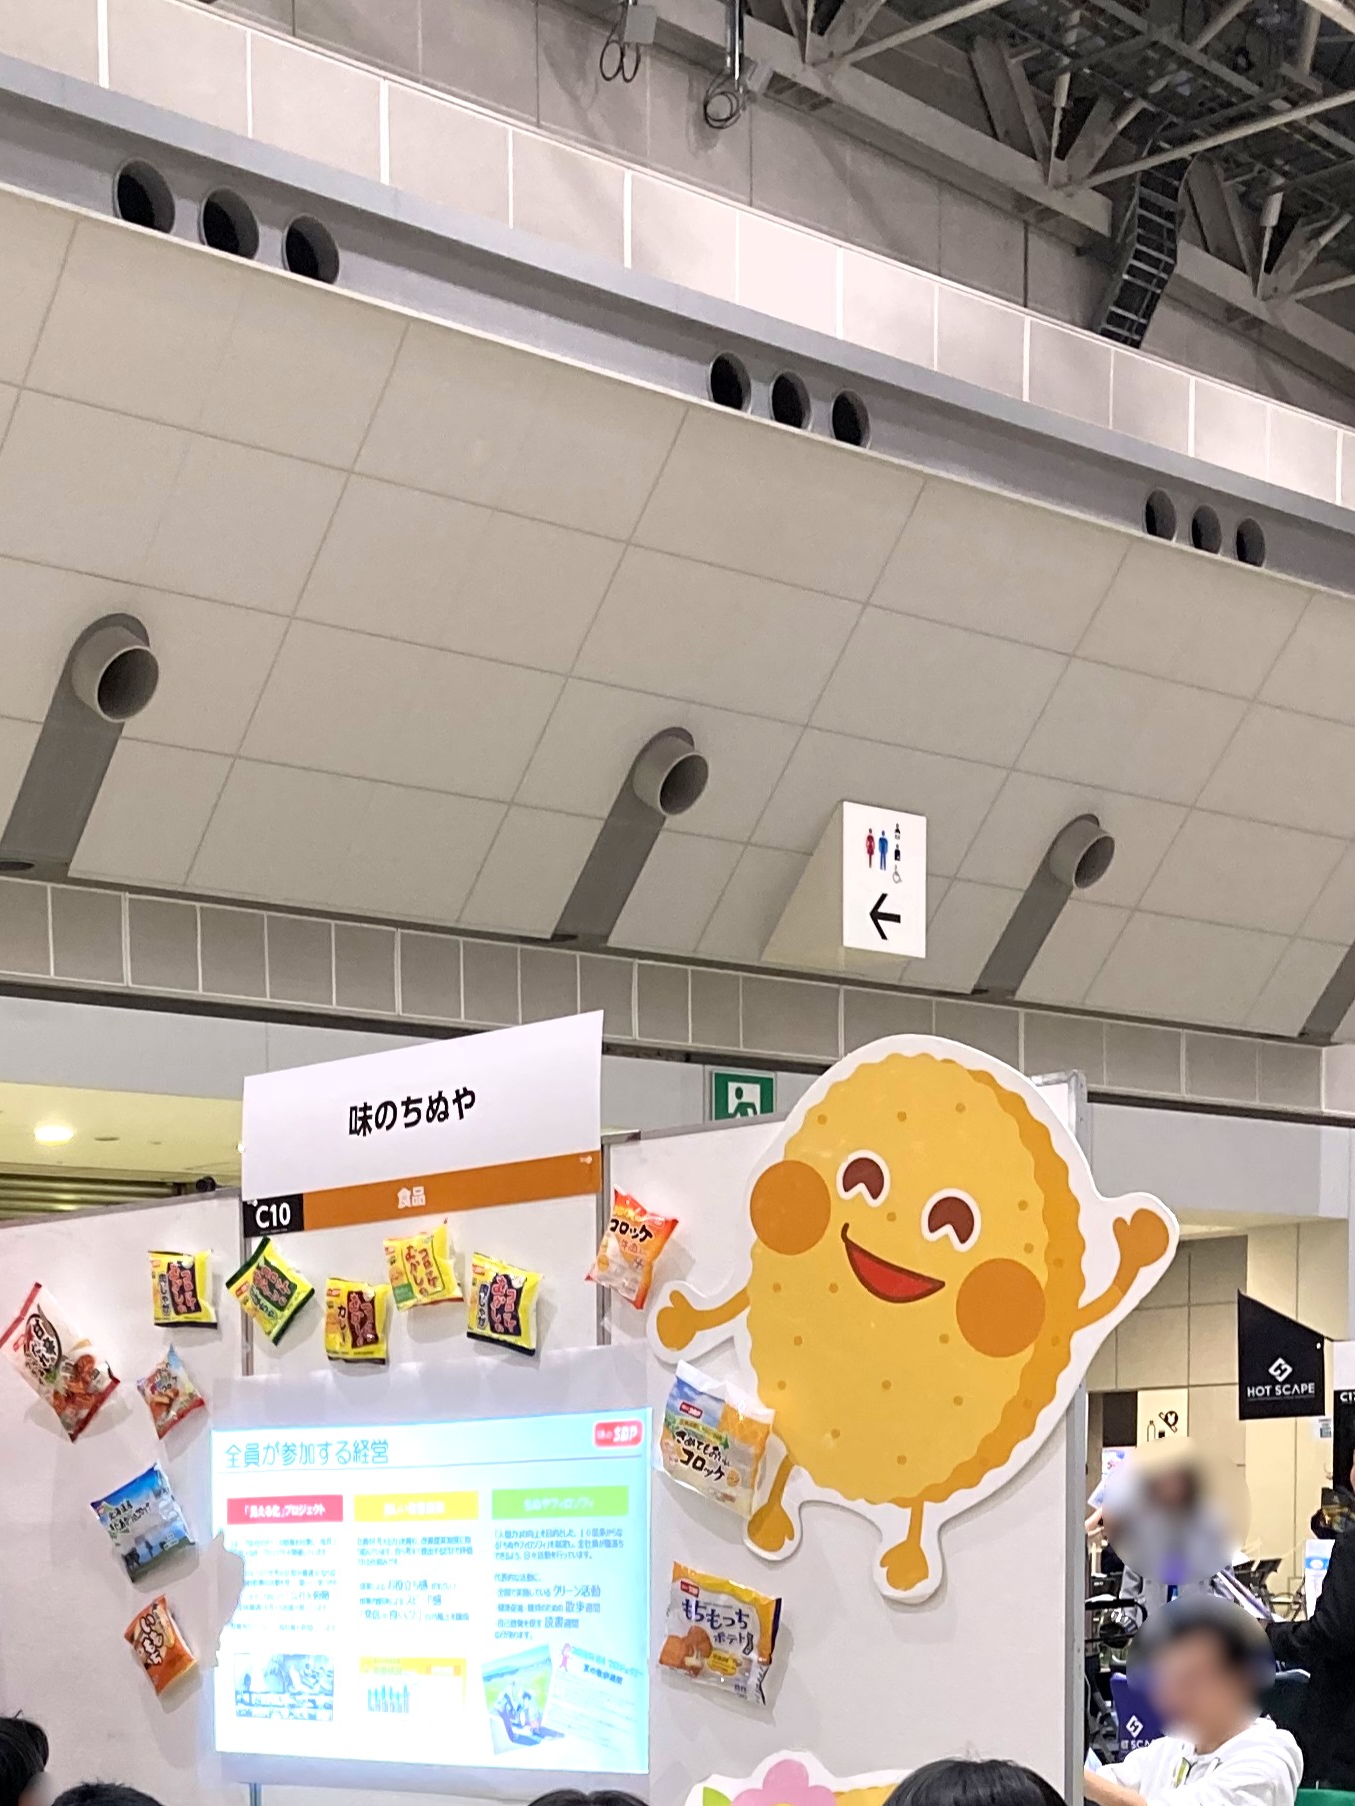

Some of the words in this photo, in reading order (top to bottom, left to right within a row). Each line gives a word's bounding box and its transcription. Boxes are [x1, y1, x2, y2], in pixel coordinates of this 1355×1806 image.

[349, 1087, 476, 1137] 味のちぬや
[397, 1186, 426, 1209] 食品
[255, 1202, 291, 1229] C10
[609, 1218, 653, 1243] コロッケ
[1247, 1385, 1272, 1397] HOT
[1275, 1382, 1315, 1396] SCAPE
[225, 1438, 389, 1468] 全員が参加する経営
[680, 1447, 725, 1482] コロッケ
[682, 1598, 749, 1630] もちもっち
[714, 1632, 745, 1645] ポテト
